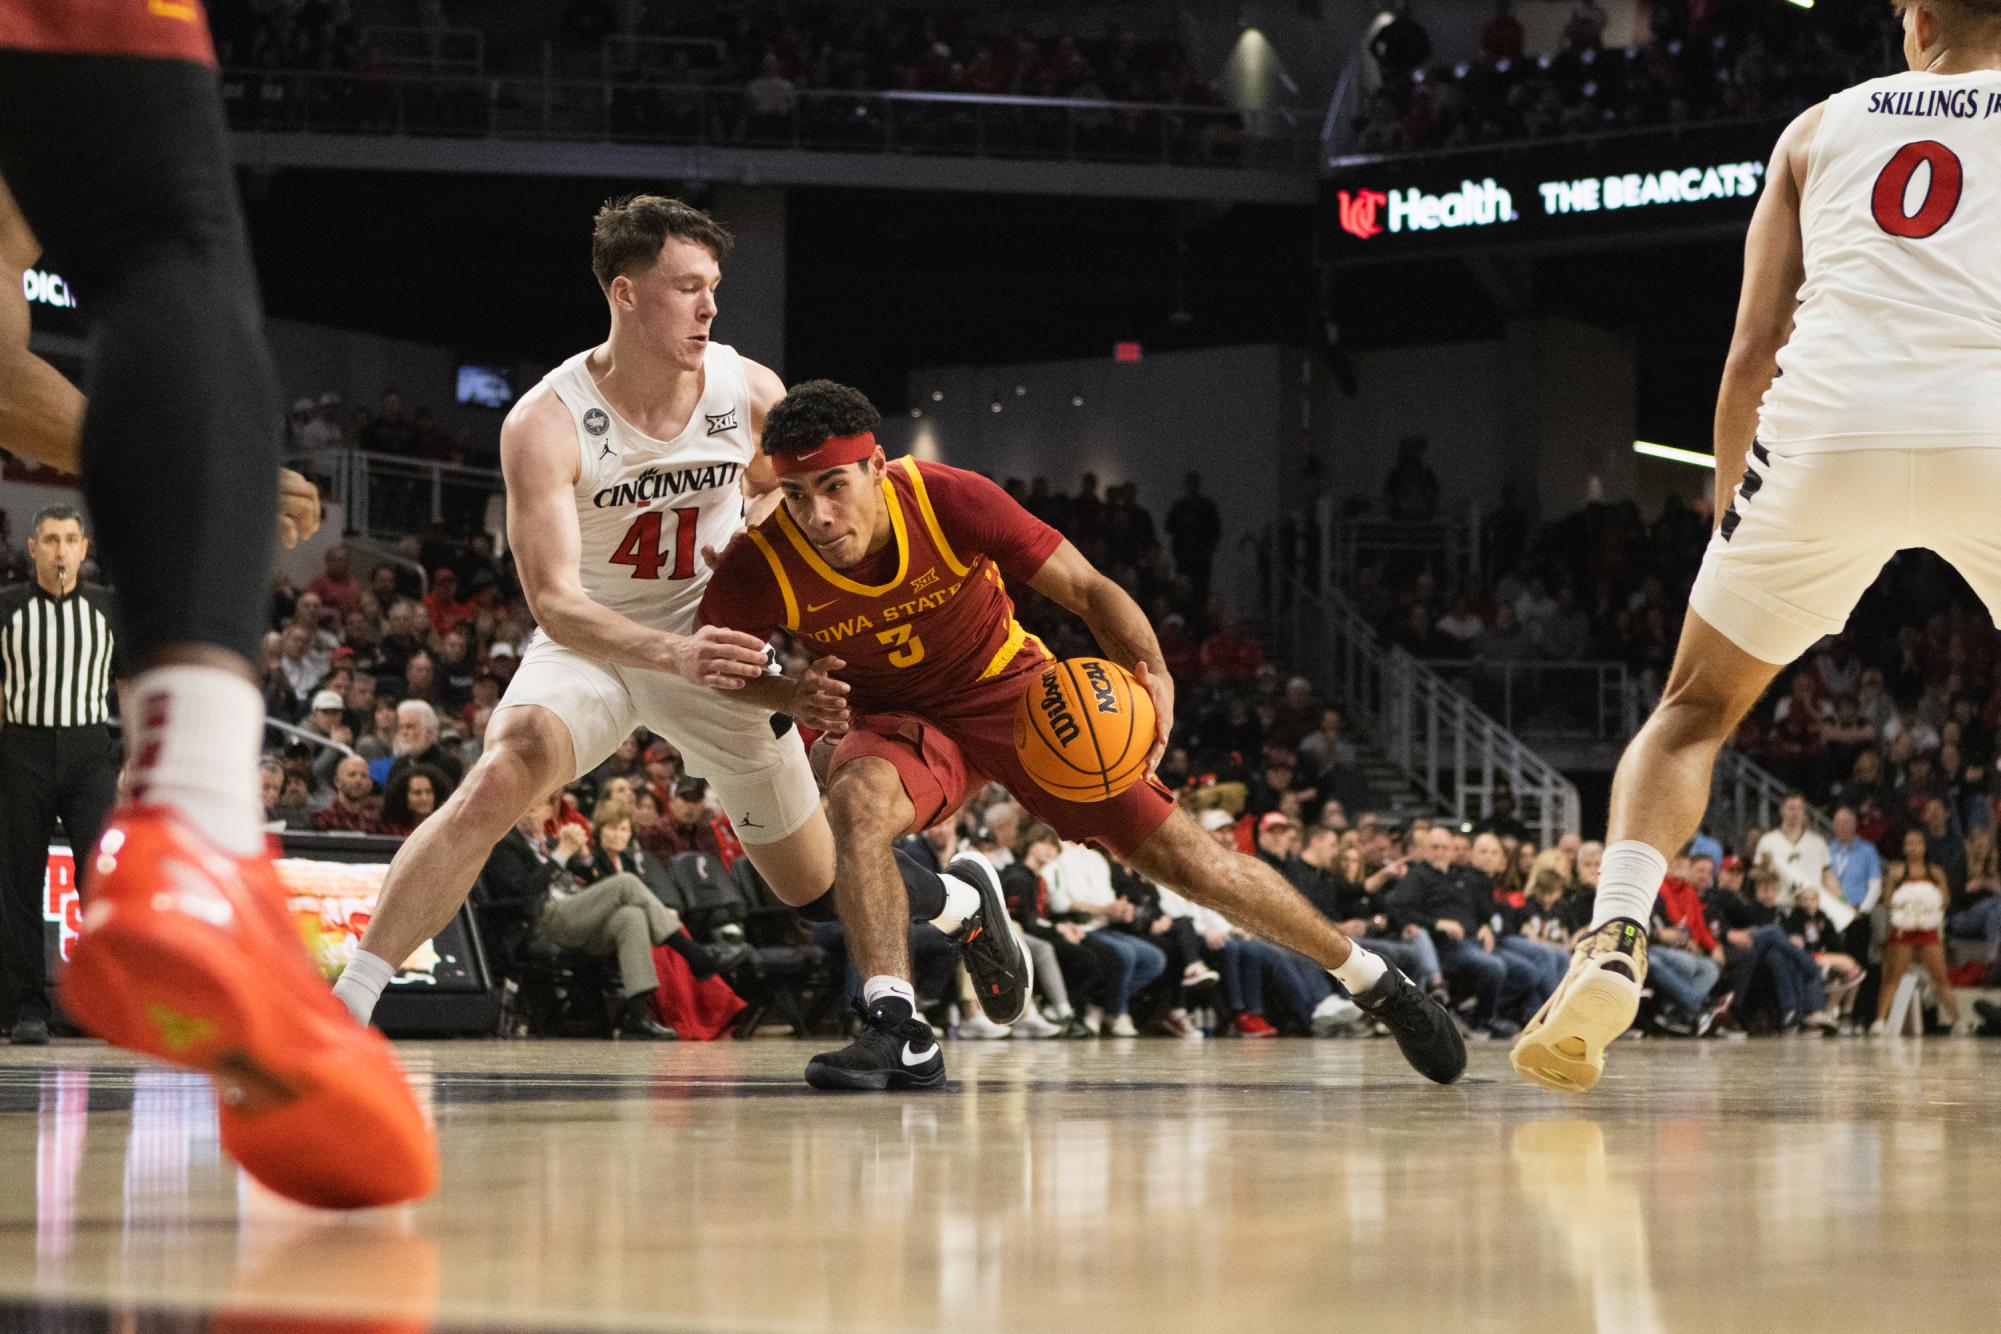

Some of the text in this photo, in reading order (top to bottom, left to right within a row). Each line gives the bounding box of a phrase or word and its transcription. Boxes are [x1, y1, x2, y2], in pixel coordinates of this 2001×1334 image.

[1868, 89, 1978, 118] SKILLINGS
[1388, 178, 1512, 233] Health
[1539, 178, 1599, 214] THE
[1871, 140, 1963, 239] 0
[593, 462, 738, 508] CINCINNATI
[608, 506, 700, 580] 41
[875, 623, 925, 668] 3
[1081, 661, 1118, 713] NCAA
